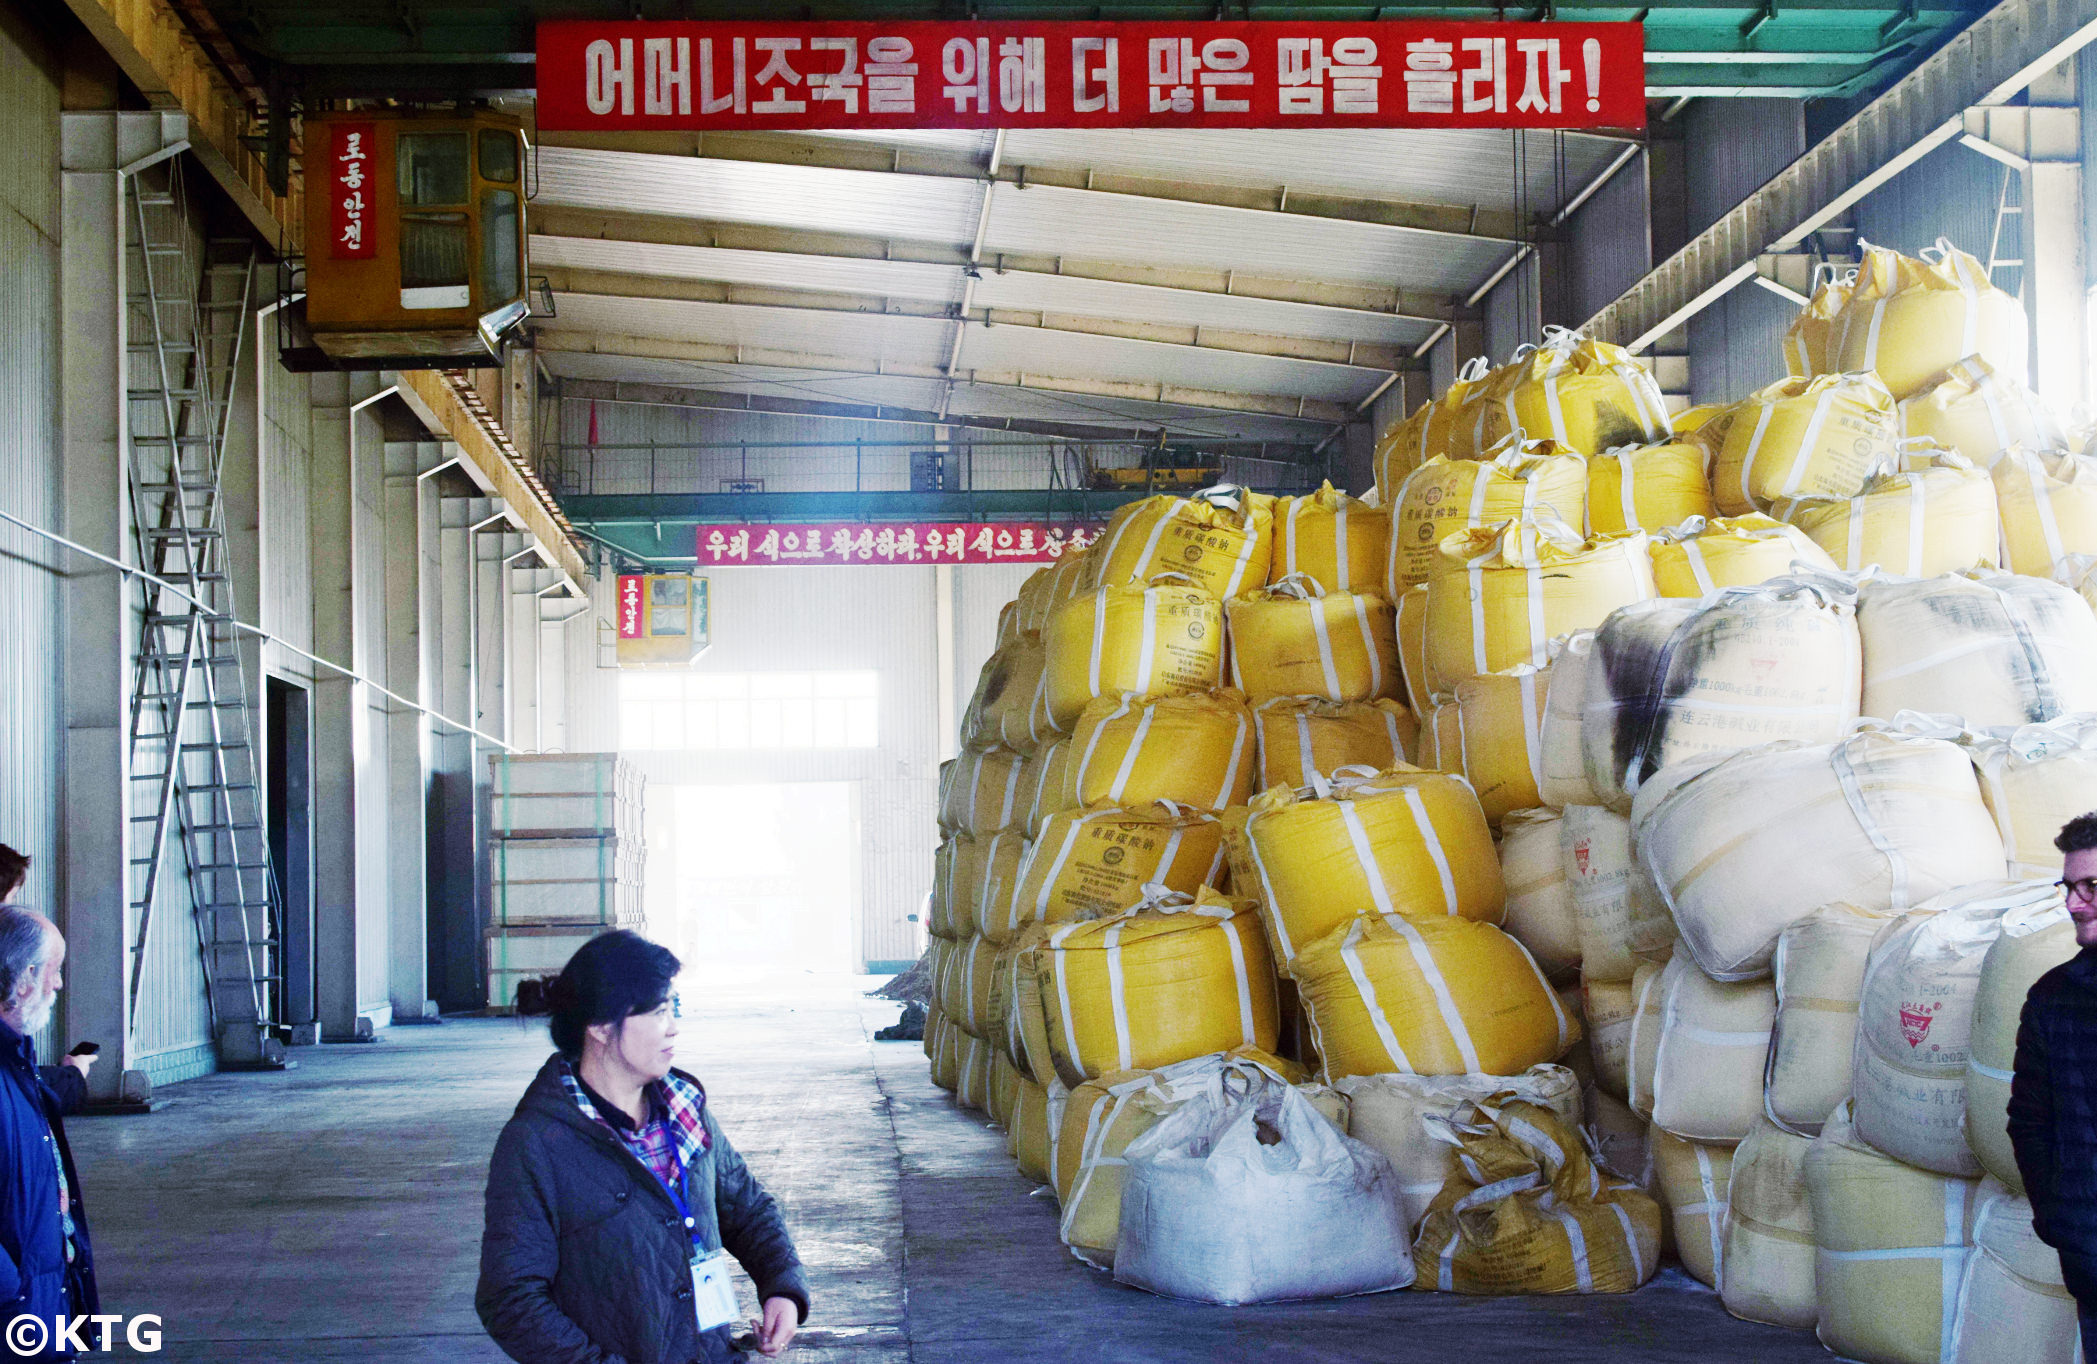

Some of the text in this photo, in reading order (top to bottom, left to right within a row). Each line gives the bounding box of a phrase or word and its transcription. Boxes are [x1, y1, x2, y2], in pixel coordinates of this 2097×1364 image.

[585, 36, 1601, 116] 어머니조국을 위해 더 많은 땀을 흘리자!
[338, 132, 367, 250] 로동안전
[705, 529, 750, 562] 우리
[753, 529, 825, 562] 식으로
[923, 528, 966, 561] 우리
[968, 527, 1038, 560] 식으로
[622, 579, 639, 634] 로동안전
